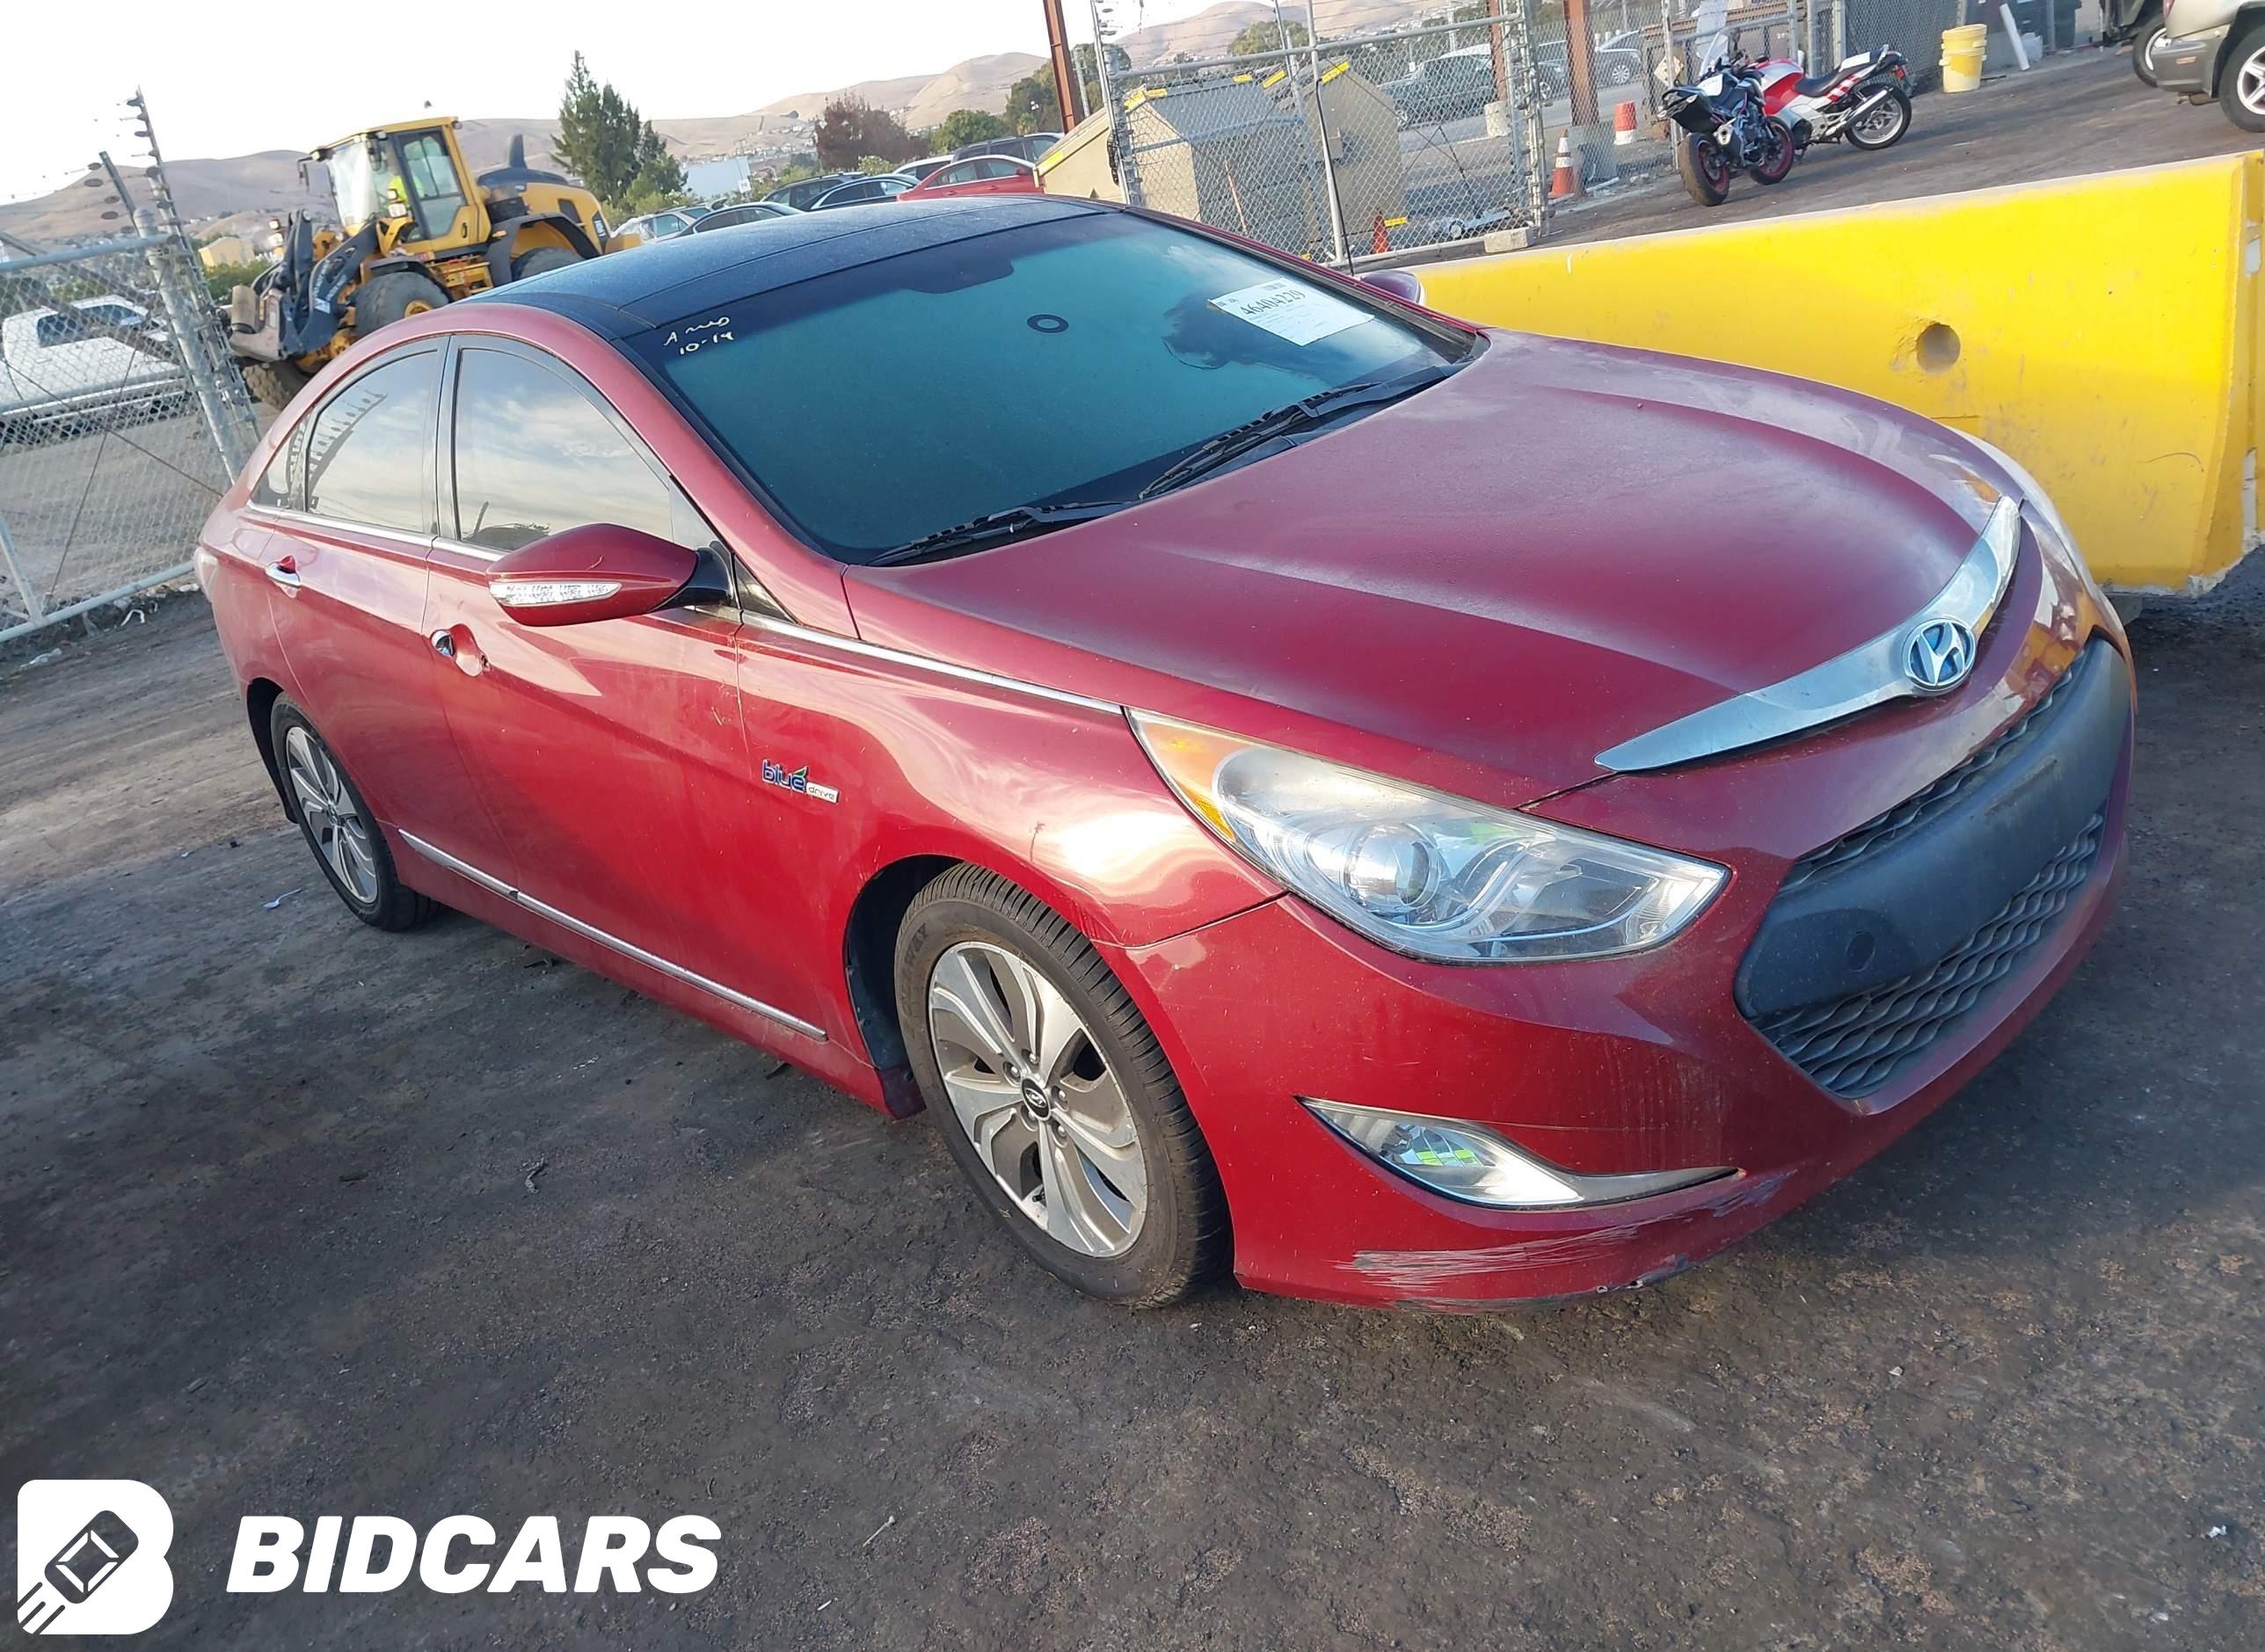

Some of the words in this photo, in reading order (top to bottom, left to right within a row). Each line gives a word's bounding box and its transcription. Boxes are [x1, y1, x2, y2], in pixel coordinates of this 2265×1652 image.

[1240, 289, 1306, 316] 46404229
[762, 760, 807, 794] blue
[808, 785, 836, 801] drive
